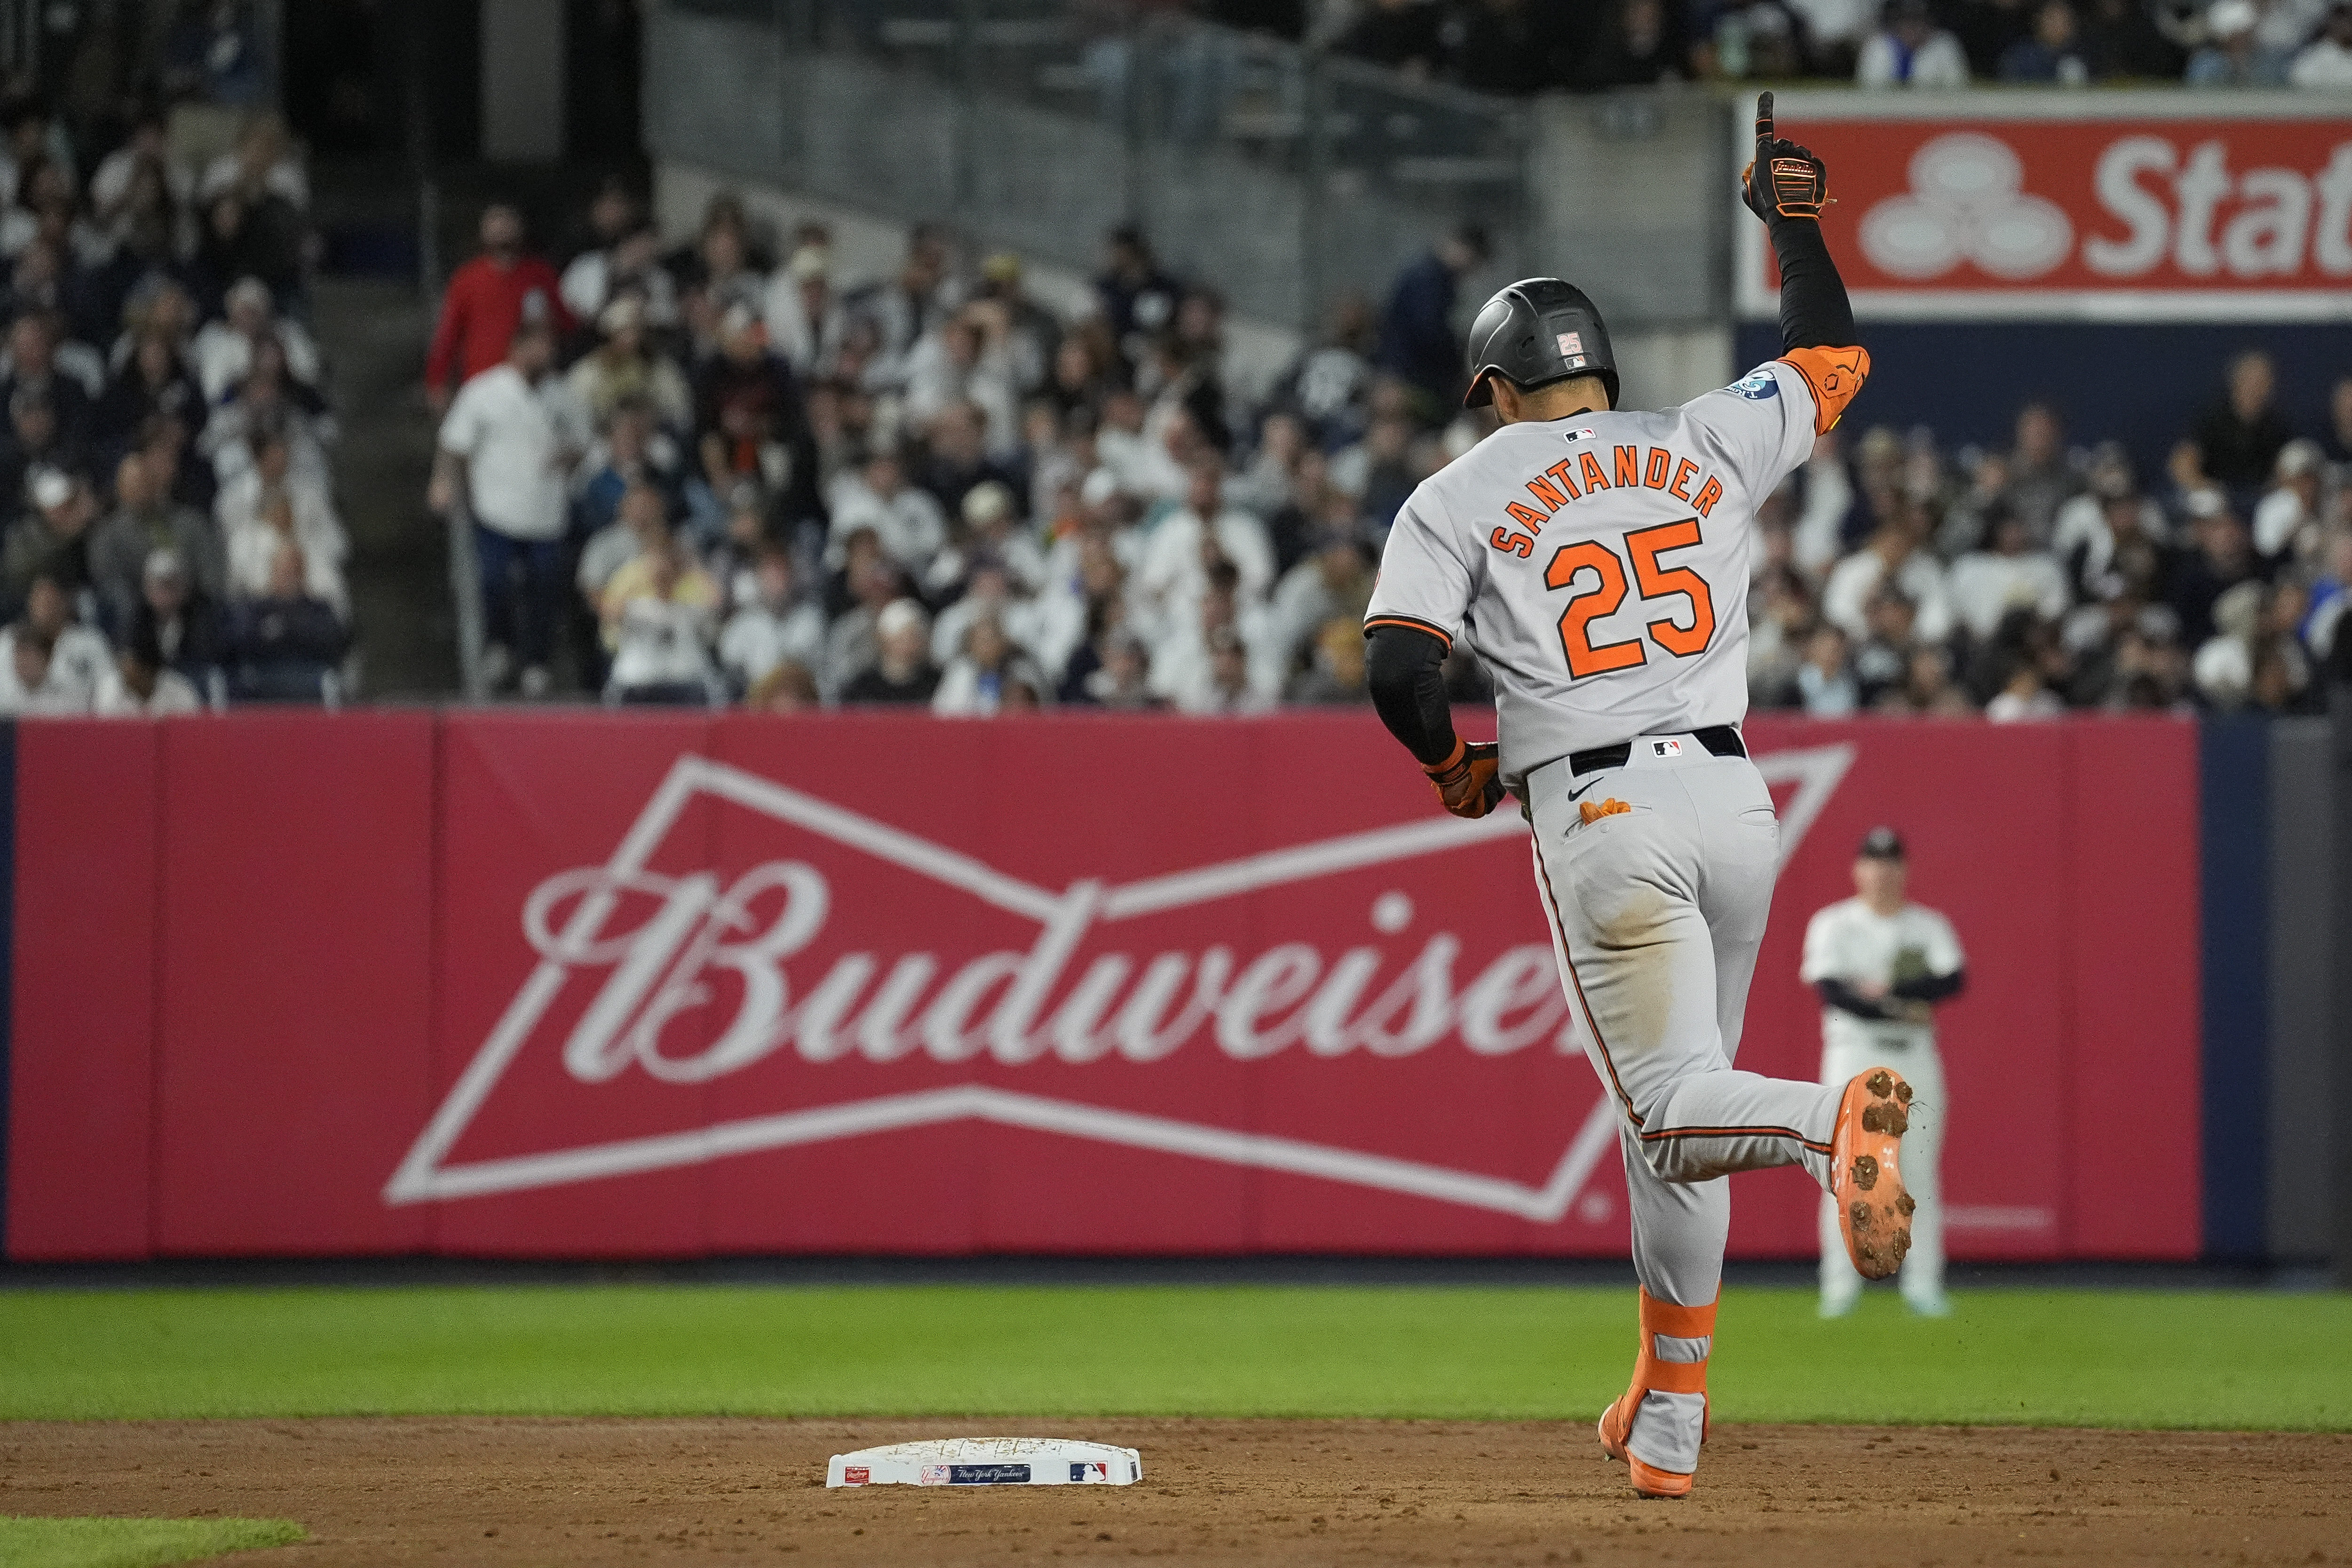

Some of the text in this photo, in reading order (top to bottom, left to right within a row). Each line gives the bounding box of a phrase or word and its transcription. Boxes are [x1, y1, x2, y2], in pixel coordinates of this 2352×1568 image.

[1559, 332, 1582, 354] 25
[1490, 445, 1723, 559] SANTANDER
[1543, 516, 1716, 681] 25
[520, 859, 1584, 1083] Budweise
[958, 1469, 1024, 1481] New York Yankees
